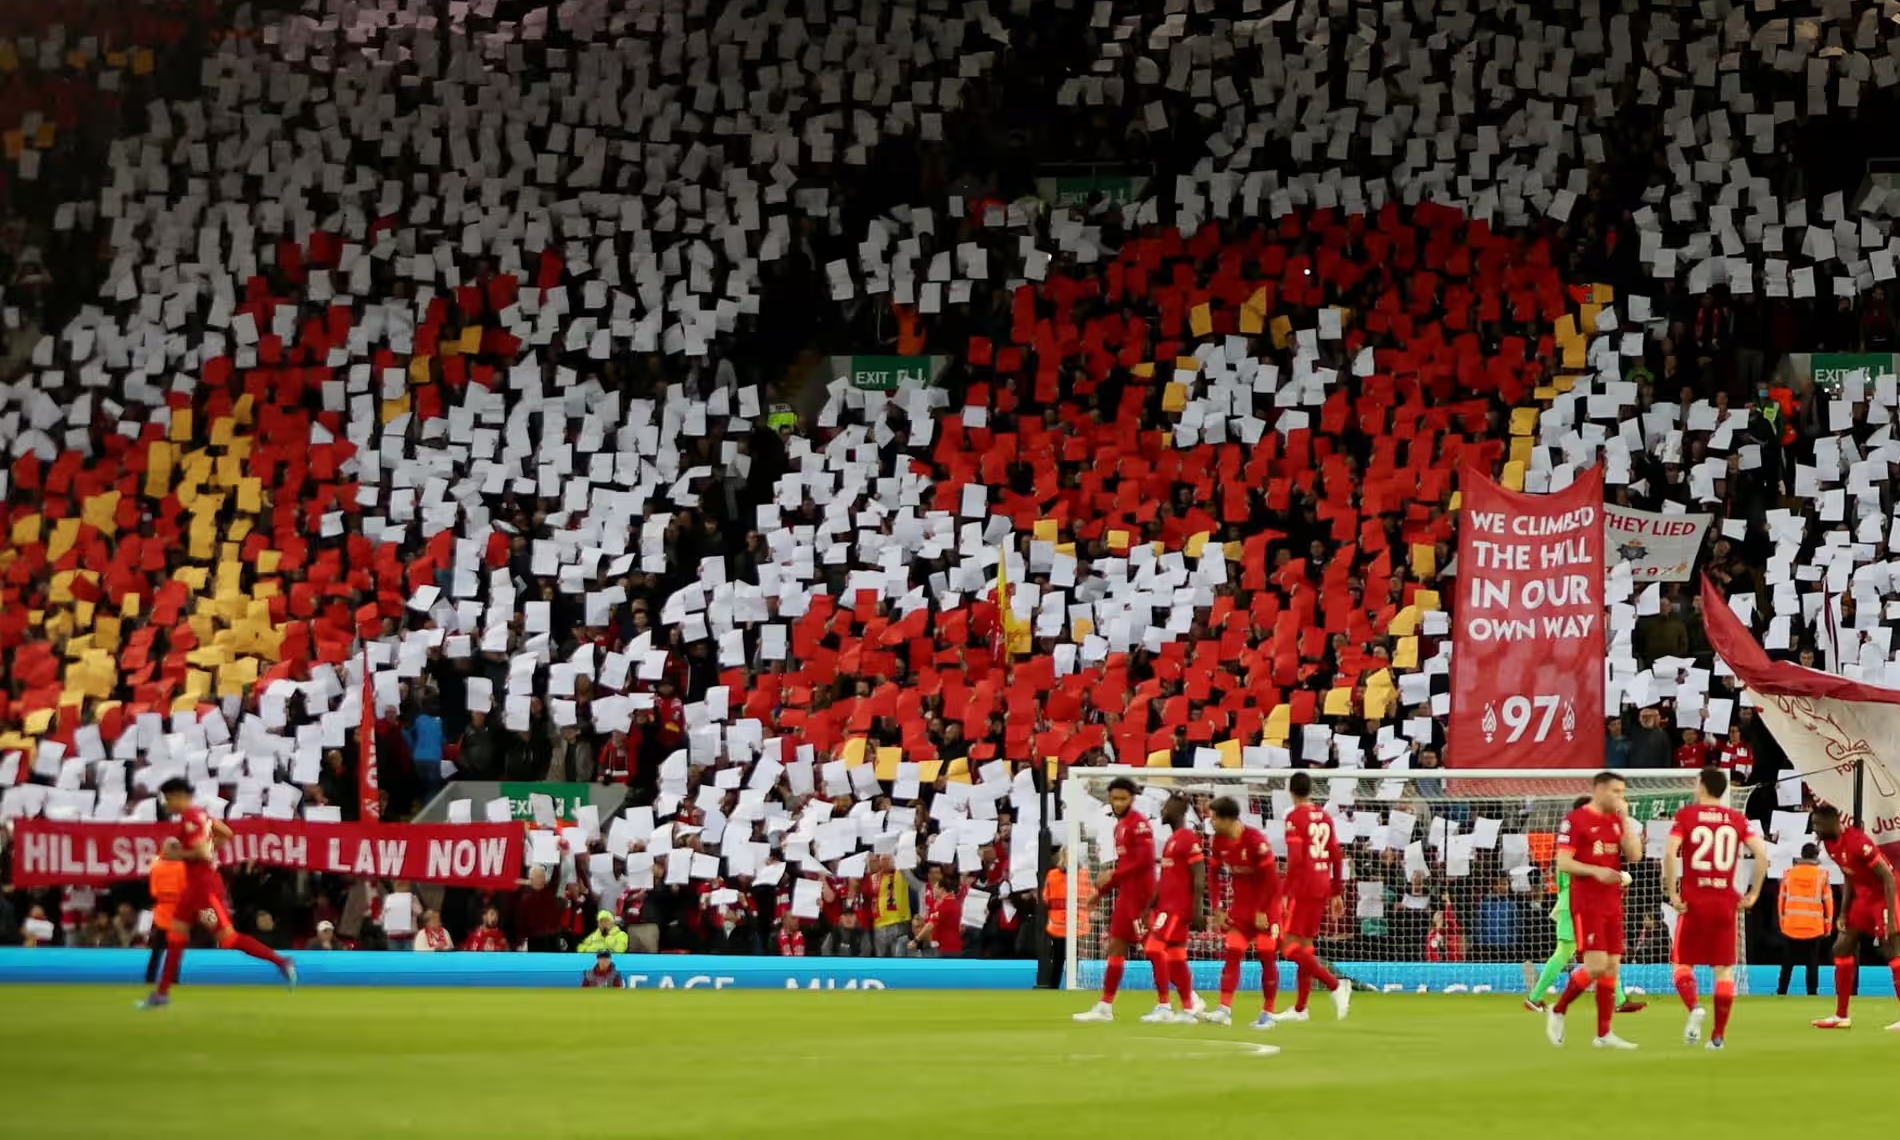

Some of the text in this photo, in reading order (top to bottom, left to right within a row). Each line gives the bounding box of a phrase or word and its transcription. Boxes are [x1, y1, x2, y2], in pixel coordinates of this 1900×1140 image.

[856, 371, 889, 385] EXIT
[1471, 510, 1505, 534] WE
[1652, 520, 1696, 536] LIED
[1472, 536, 1592, 570] THE HILL
[1471, 575, 1592, 610] IN OUR
[1468, 614, 1594, 642] OWN WAY
[1502, 695, 1560, 743] 97
[510, 799, 533, 815] EXI
[24, 832, 508, 878] HILLSBOUGH LAW NOW
[1308, 822, 1330, 859] 32
[1691, 825, 1738, 872] 20
